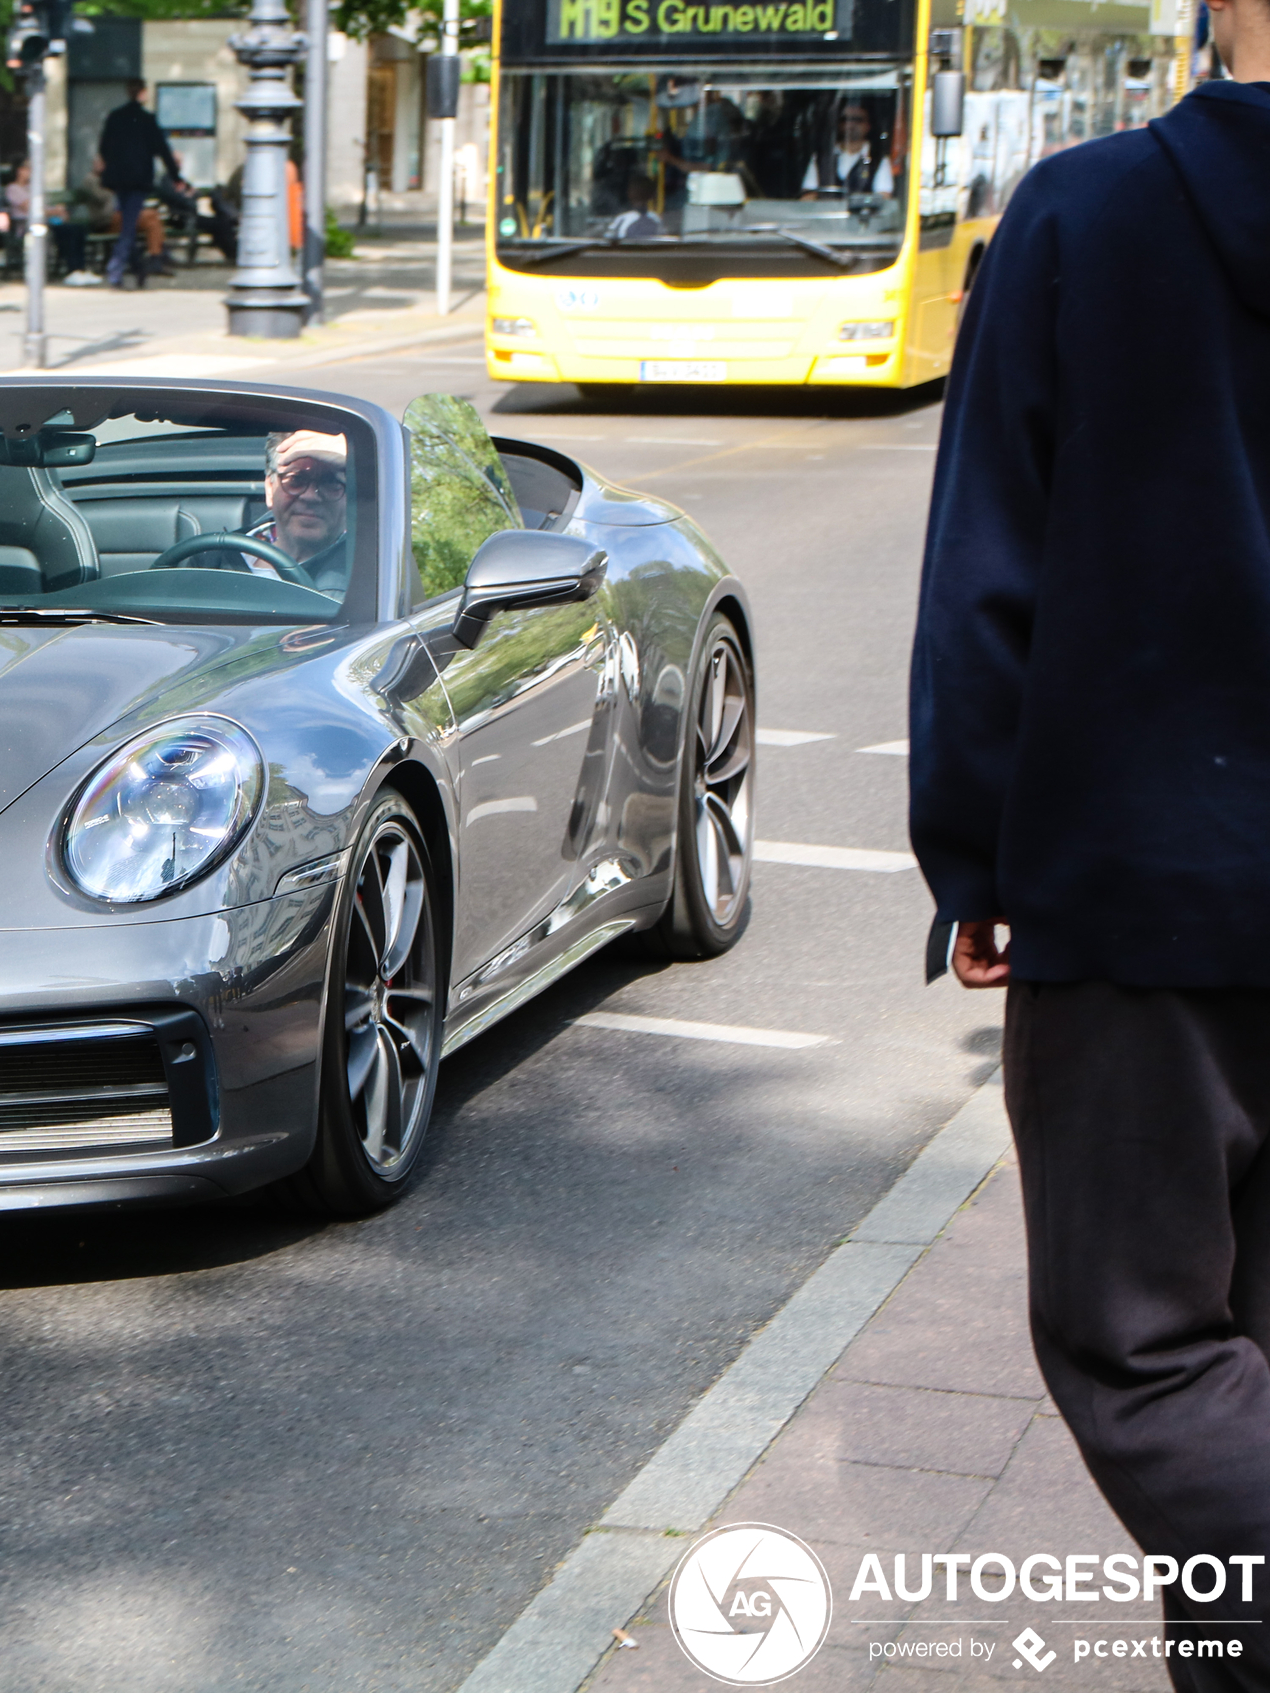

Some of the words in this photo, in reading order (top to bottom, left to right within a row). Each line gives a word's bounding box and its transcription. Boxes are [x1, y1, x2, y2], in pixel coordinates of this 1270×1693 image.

[559, 0, 620, 38] M19
[624, 0, 650, 33] S
[657, 0, 834, 33] Grunewald
